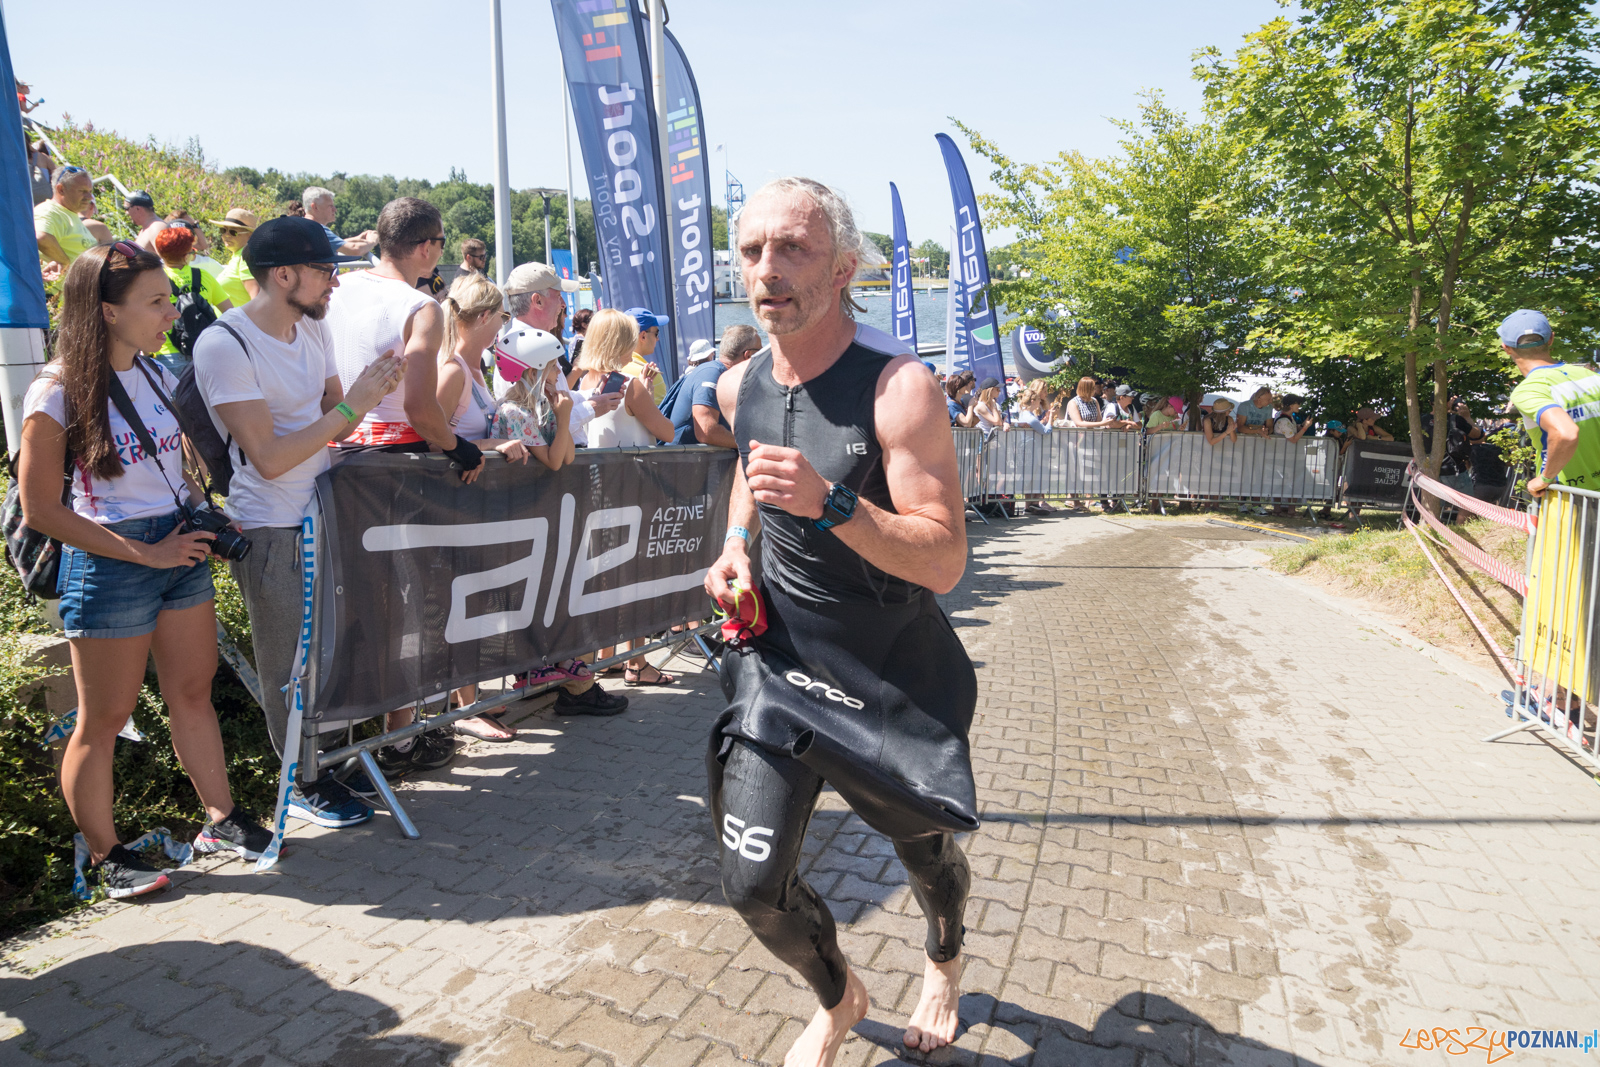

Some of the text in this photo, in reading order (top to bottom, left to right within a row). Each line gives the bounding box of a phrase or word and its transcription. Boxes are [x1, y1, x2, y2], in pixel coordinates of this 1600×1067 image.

[117, 427, 181, 466] KRKÓ
[1373, 466, 1400, 474] ENERGY
[1374, 477, 1398, 485] ACTIVE
[1566, 475, 1584, 487] TYR
[651, 505, 704, 522] ACTIVE
[649, 523, 683, 540] LIFE
[646, 536, 703, 558] ENERGY
[785, 671, 865, 711] orca
